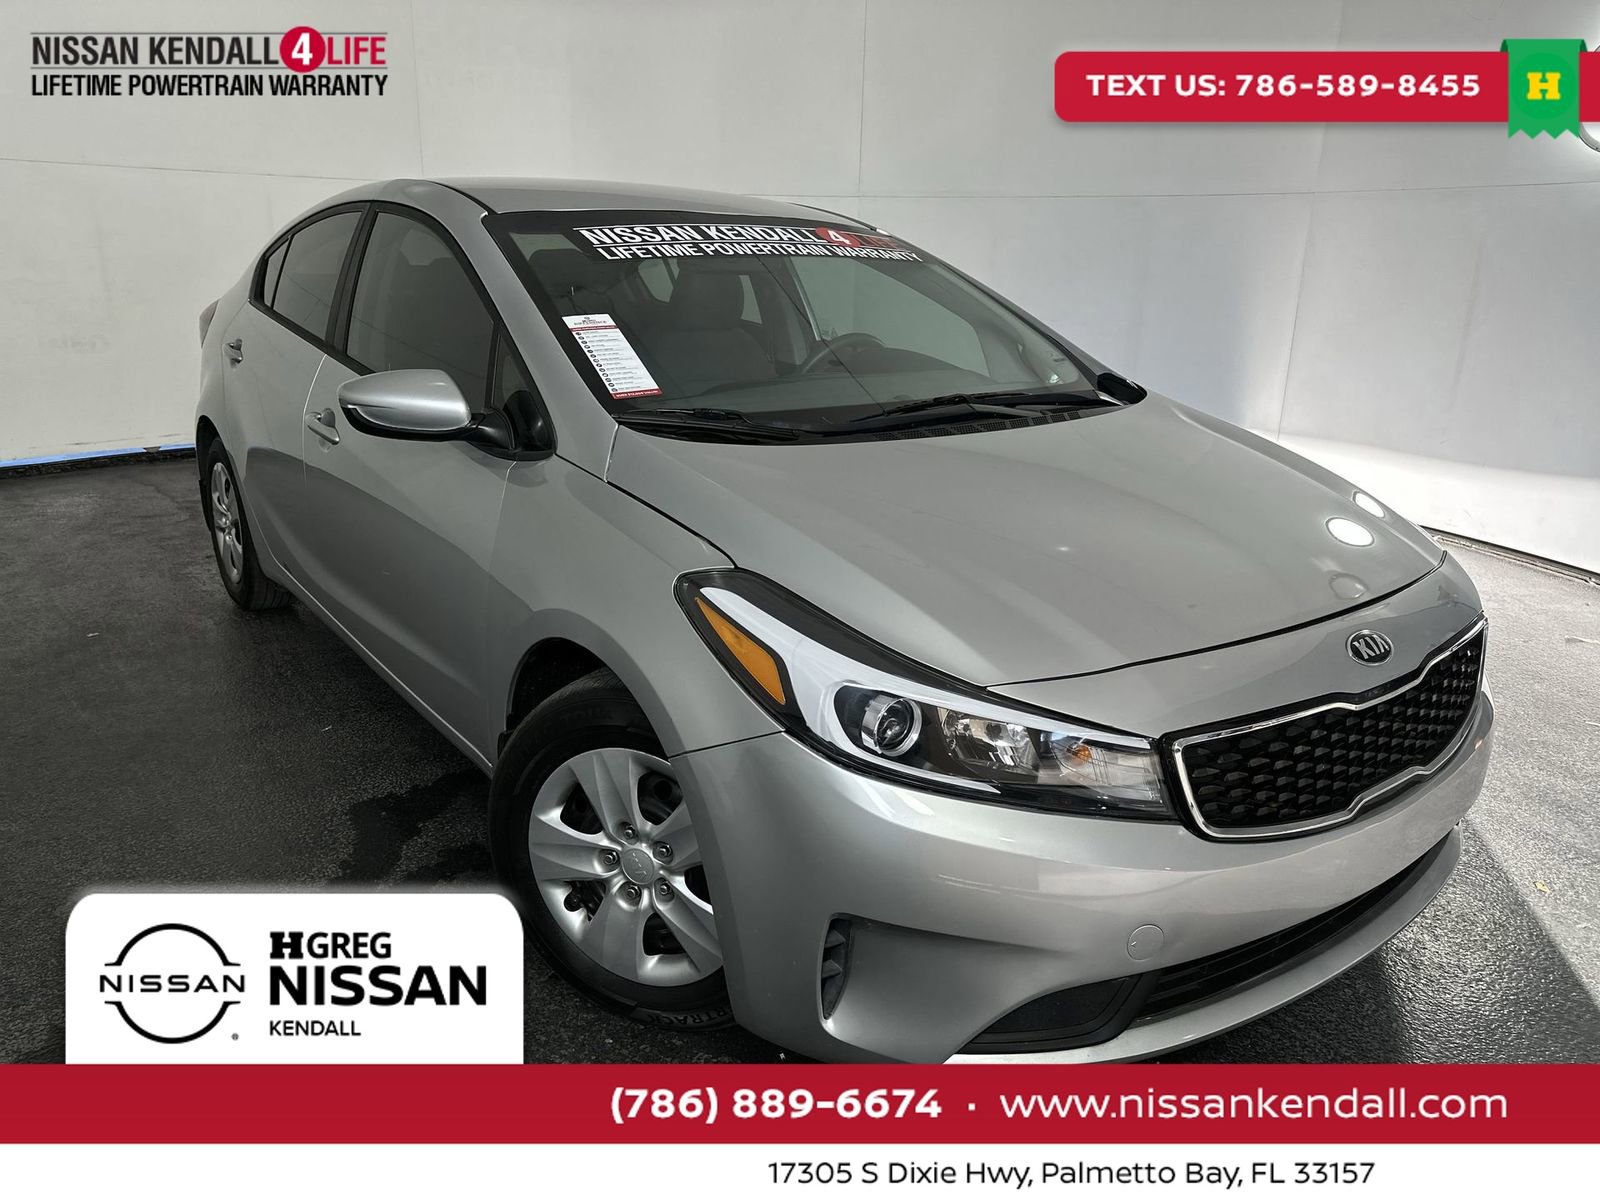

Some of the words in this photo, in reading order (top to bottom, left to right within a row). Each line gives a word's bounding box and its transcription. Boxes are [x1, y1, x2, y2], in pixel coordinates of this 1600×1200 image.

[579, 226, 703, 245] NISSAN
[701, 226, 828, 244] KENDALL
[828, 230, 852, 245] 4
[596, 244, 704, 260] LIFETIME
[701, 243, 832, 256] POWERTRAIN
[830, 245, 924, 263] WARRANTY
[1352, 634, 1390, 660] KIA
